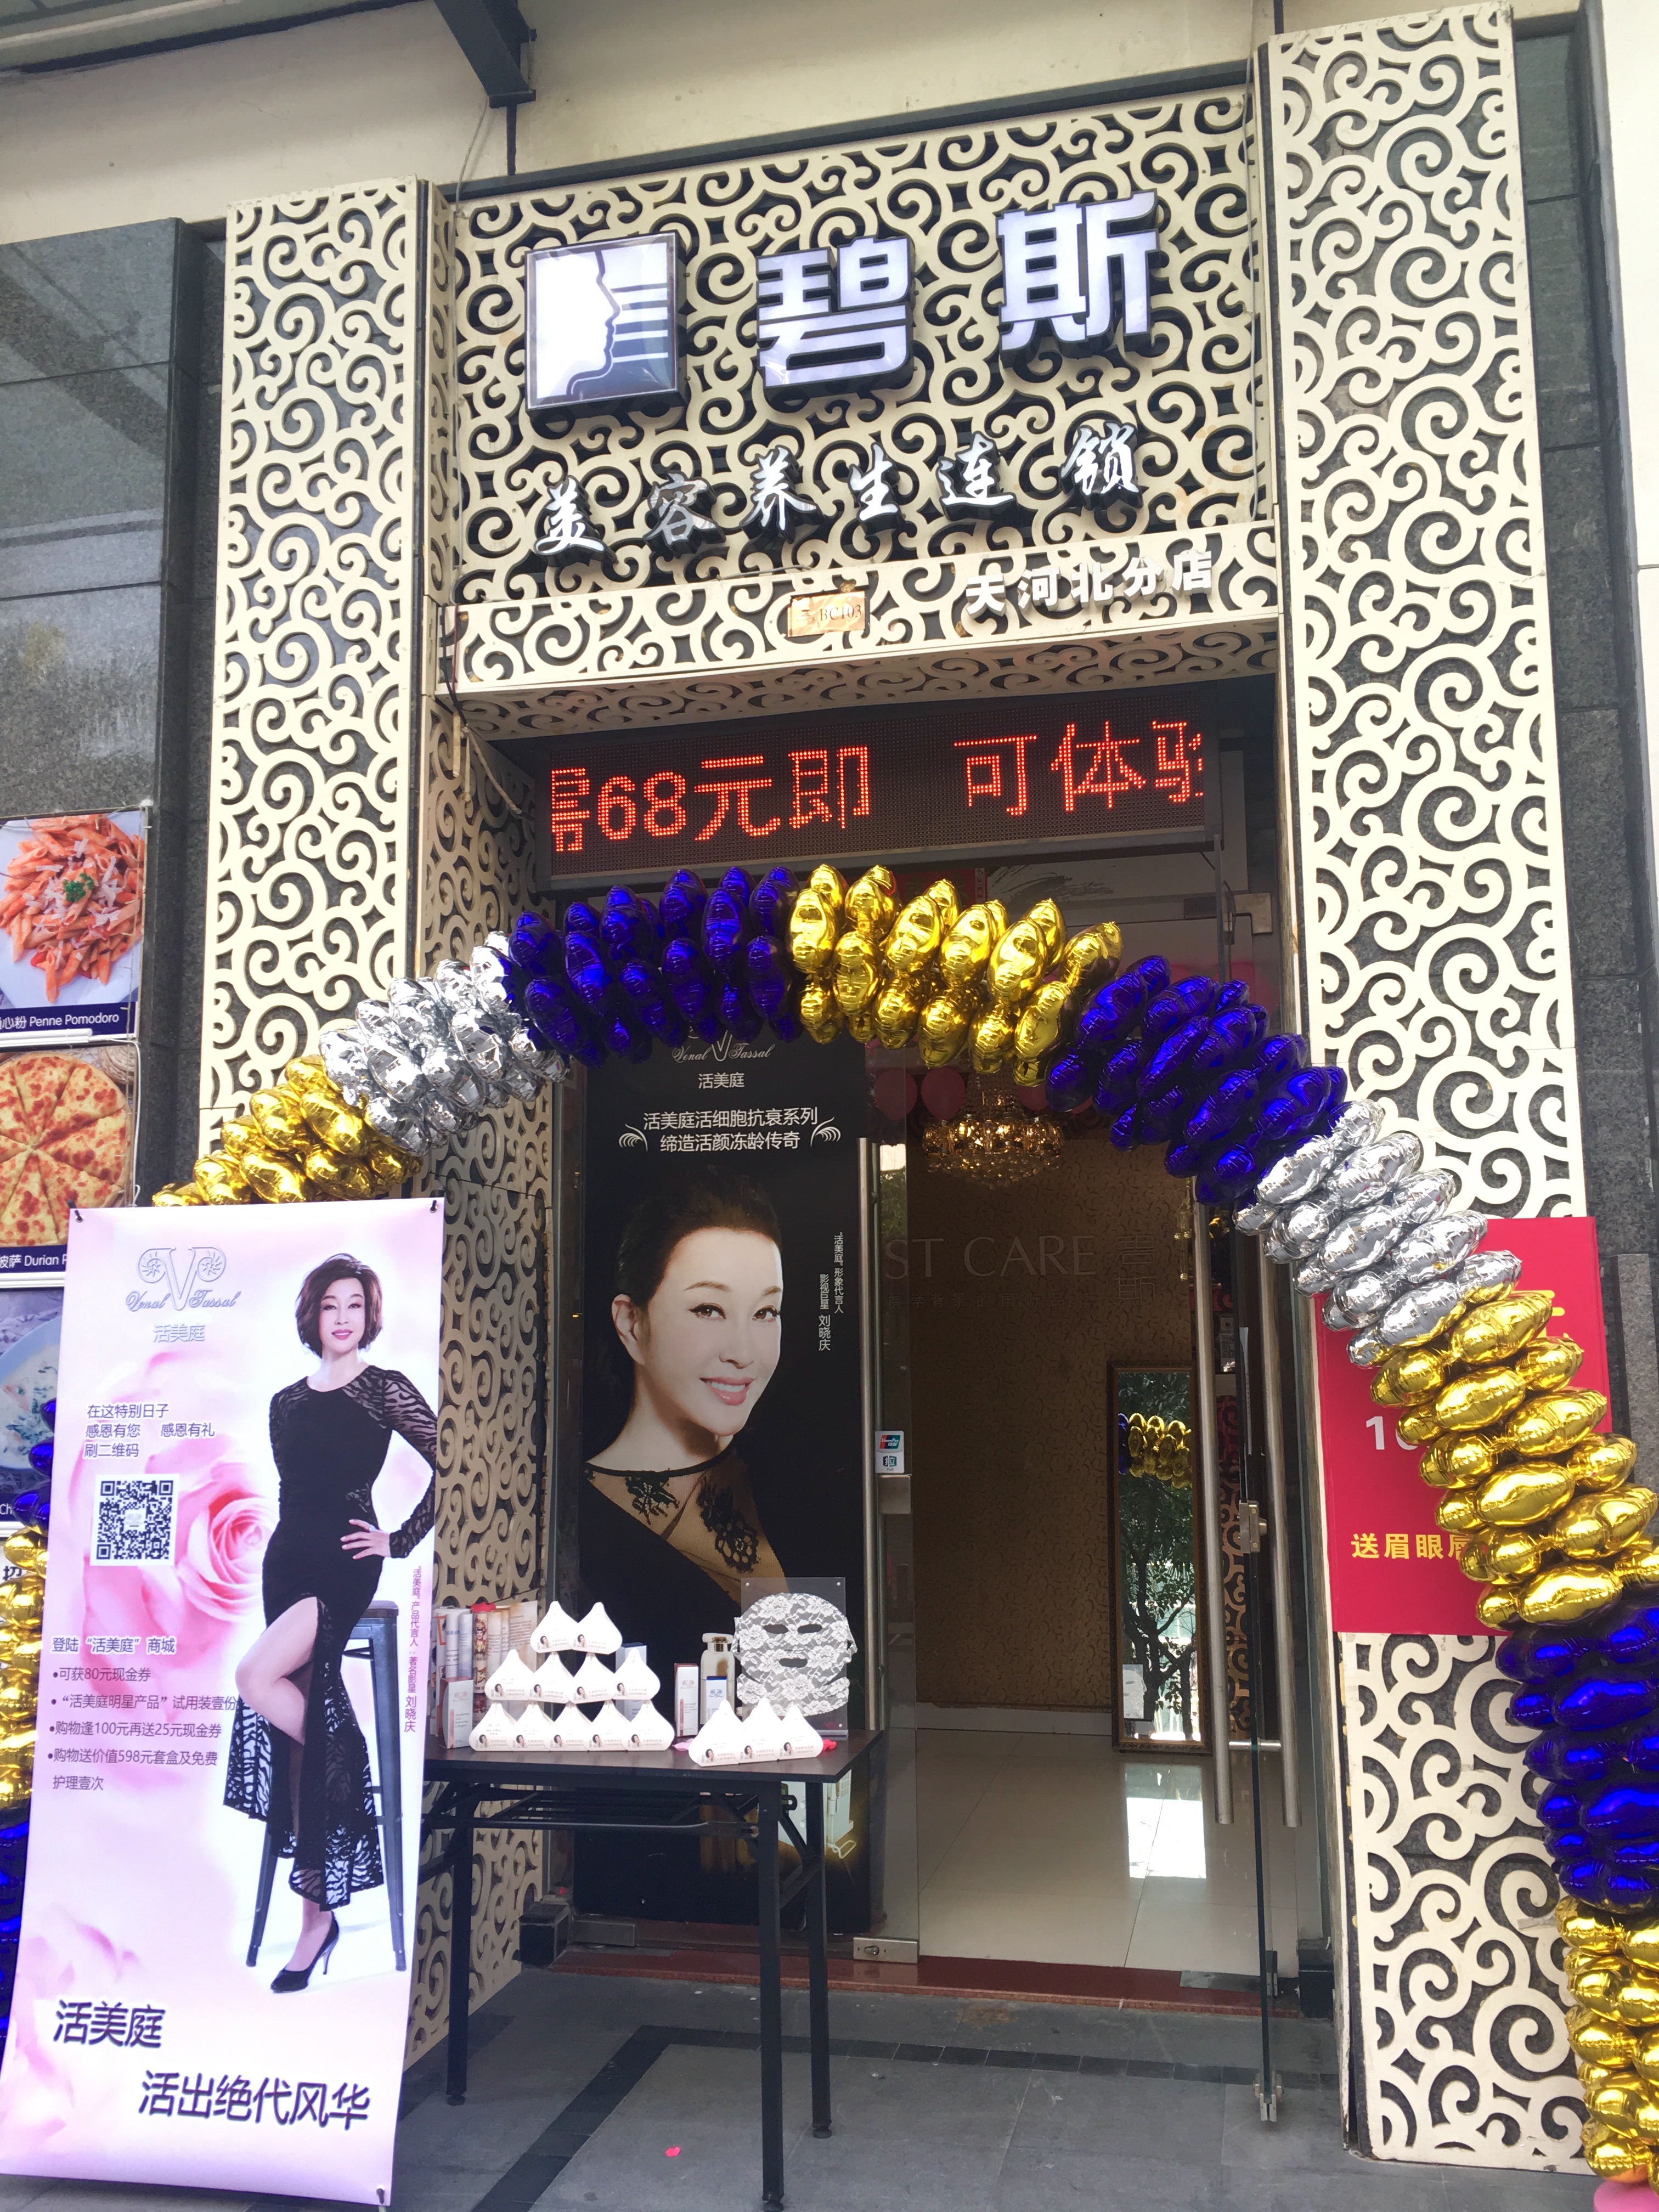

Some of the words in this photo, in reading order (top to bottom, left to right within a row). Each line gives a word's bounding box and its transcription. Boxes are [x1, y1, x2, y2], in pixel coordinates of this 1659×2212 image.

[757, 190, 1159, 387] 碧斯
[534, 421, 1139, 556] 美容养生连锁
[966, 550, 1212, 617] 天河北分店
[820, 605, 861, 622] BC103
[30, 1016, 62, 1027] Penne
[65, 1012, 119, 1024] Pomodoro
[698, 1072, 745, 1089] 活美庭
[644, 1107, 818, 1130] 活美庭活细胞抗衰系列
[660, 1131, 800, 1153] 缔造活颜冻龄传奇
[24, 1255, 59, 1266] Durian
[964, 1235, 1097, 1277] CARE
[153, 1323, 205, 1342] 活美庭
[819, 1314, 831, 1351] 刘晓庆
[87, 1403, 169, 1419] 在这特别日子
[86, 1423, 140, 1438] 感恩有您
[160, 1423, 215, 1437] 感恩有礼
[84, 1443, 139, 1458] 刷二维码
[52, 1775, 104, 1791] 护理壹次
[53, 1999, 166, 2048] 活美庭
[138, 2069, 371, 2131] 活出绝代风华
